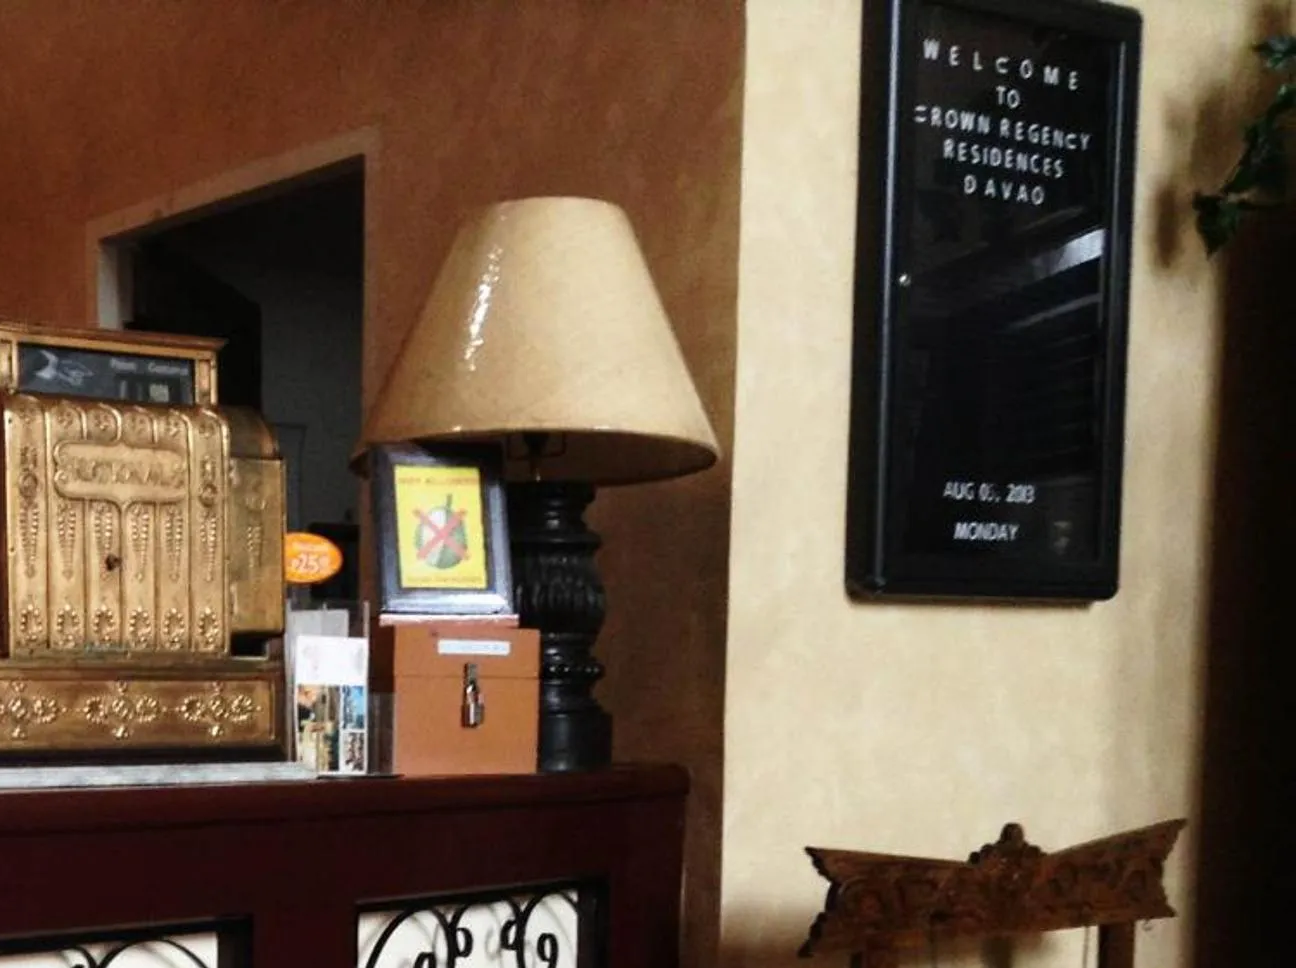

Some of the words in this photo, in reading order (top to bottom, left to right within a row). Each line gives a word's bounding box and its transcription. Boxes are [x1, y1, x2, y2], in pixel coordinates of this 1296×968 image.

[923, 38, 1079, 90] WELCOME
[996, 85, 1021, 109] TO
[999, 117, 1092, 150] REGENCY
[943, 138, 1064, 178] RESIDENCES
[963, 174, 1045, 206] DAVAO
[943, 481, 975, 500] AUG
[954, 521, 1020, 541] MONDAY
